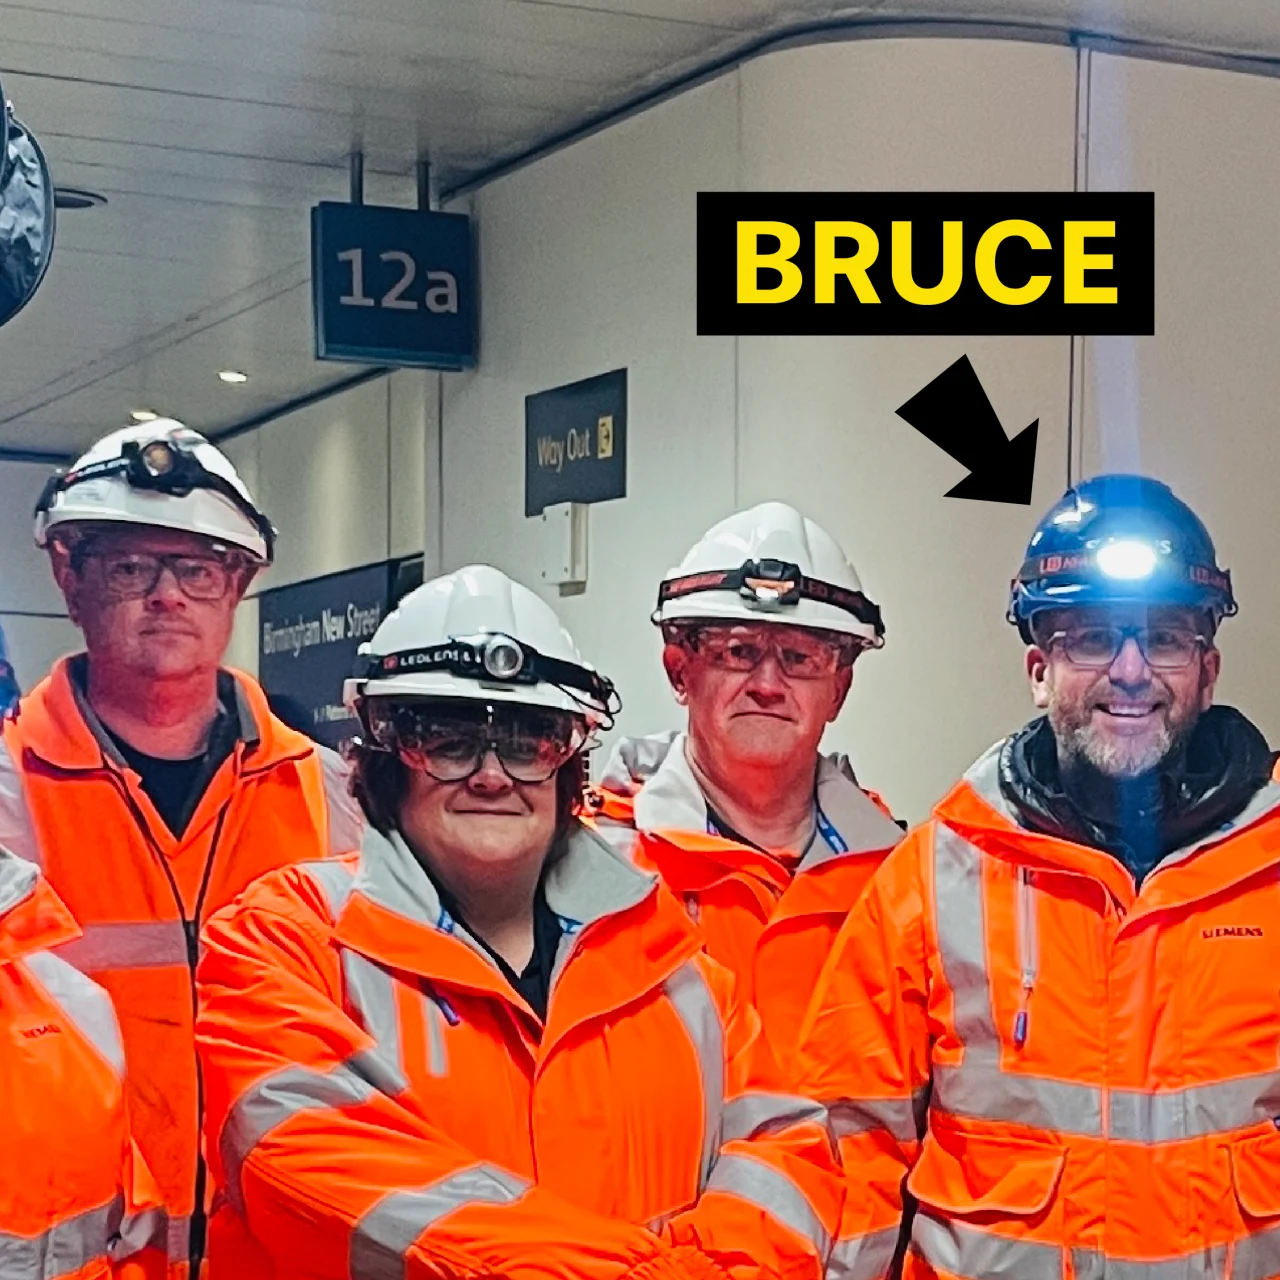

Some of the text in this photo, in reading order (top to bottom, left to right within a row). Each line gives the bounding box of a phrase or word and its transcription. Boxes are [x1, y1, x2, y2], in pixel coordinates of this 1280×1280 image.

[337, 248, 458, 314] 12a
[537, 427, 590, 473] Way Out
[263, 602, 380, 658] Birmingham New Street
